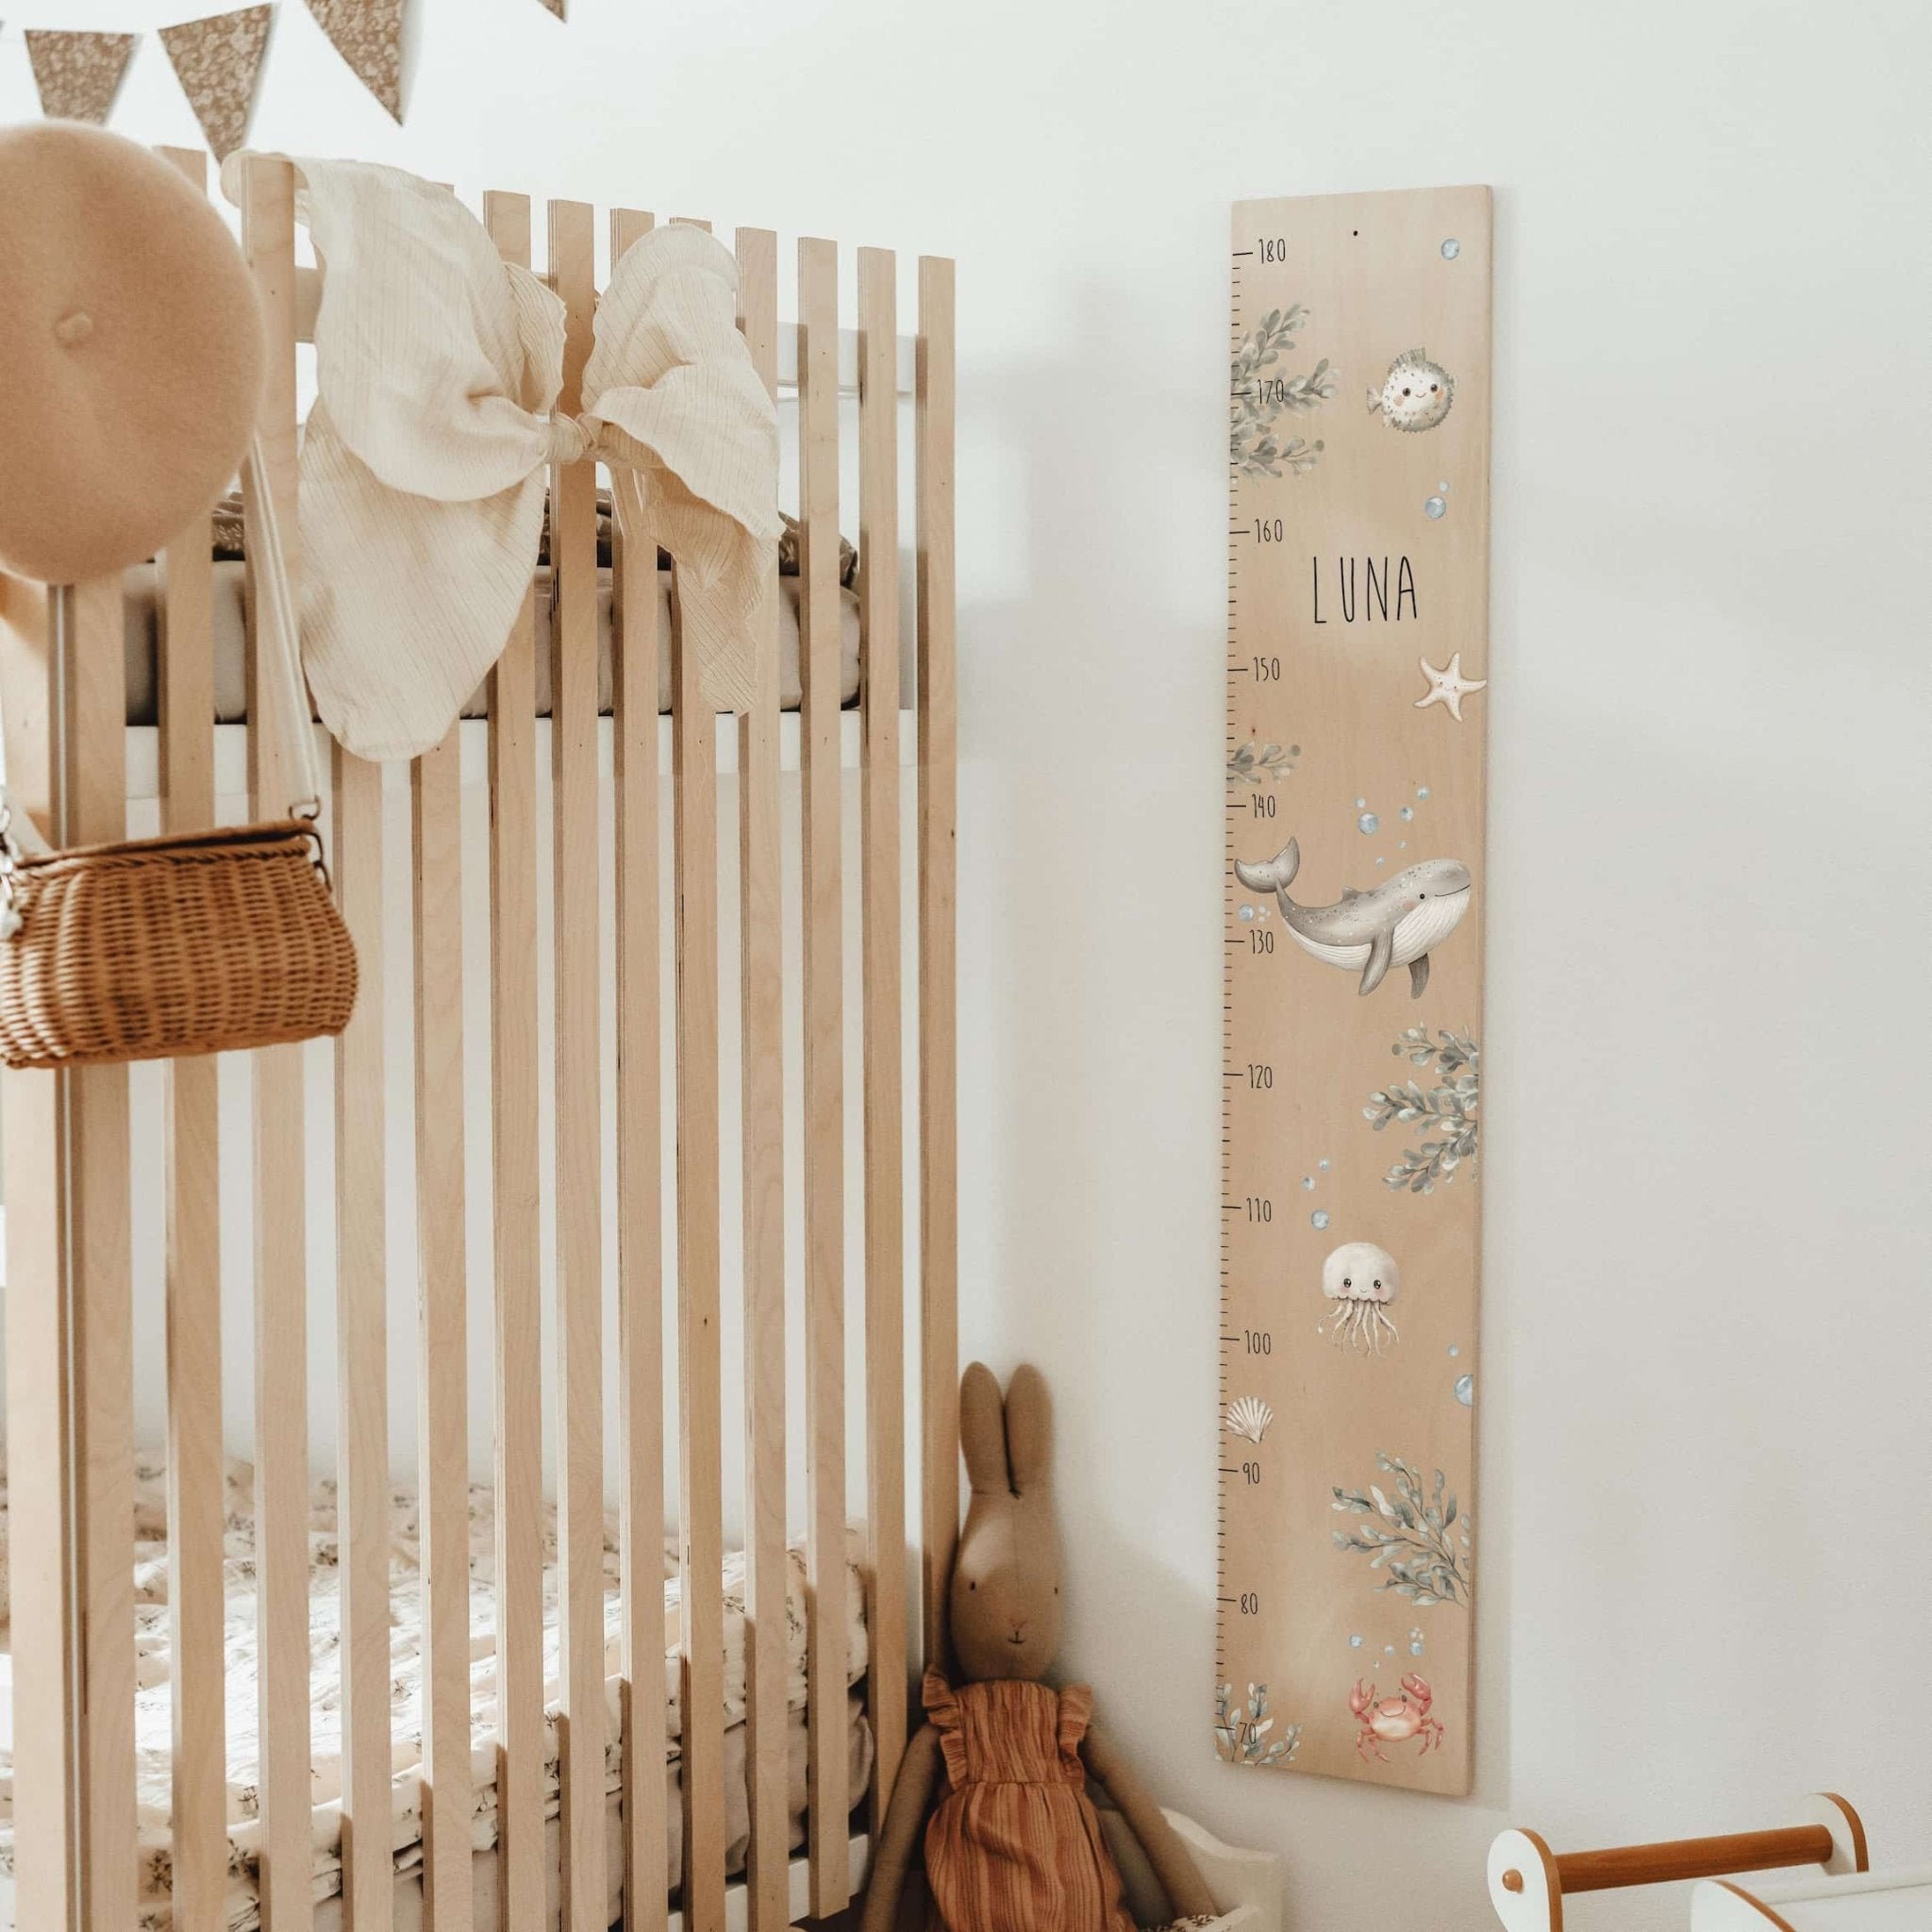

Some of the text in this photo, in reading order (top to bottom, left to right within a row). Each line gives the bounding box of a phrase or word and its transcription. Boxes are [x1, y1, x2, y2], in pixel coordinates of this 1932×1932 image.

[1257, 239, 1286, 264] 180
[1257, 378, 1284, 405] 170
[1255, 518, 1283, 543] 160
[1313, 556, 1417, 624] LUNA
[1253, 657, 1280, 682] 150
[1251, 793, 1275, 819] 140
[1249, 929, 1274, 955] 130
[1247, 1063, 1273, 1089] 120
[1246, 1197, 1272, 1223] 110
[1244, 1329, 1272, 1356] 100
[1242, 1461, 1260, 1485] 90
[1241, 1592, 1258, 1616] 80
[1239, 1722, 1257, 1745] 70
